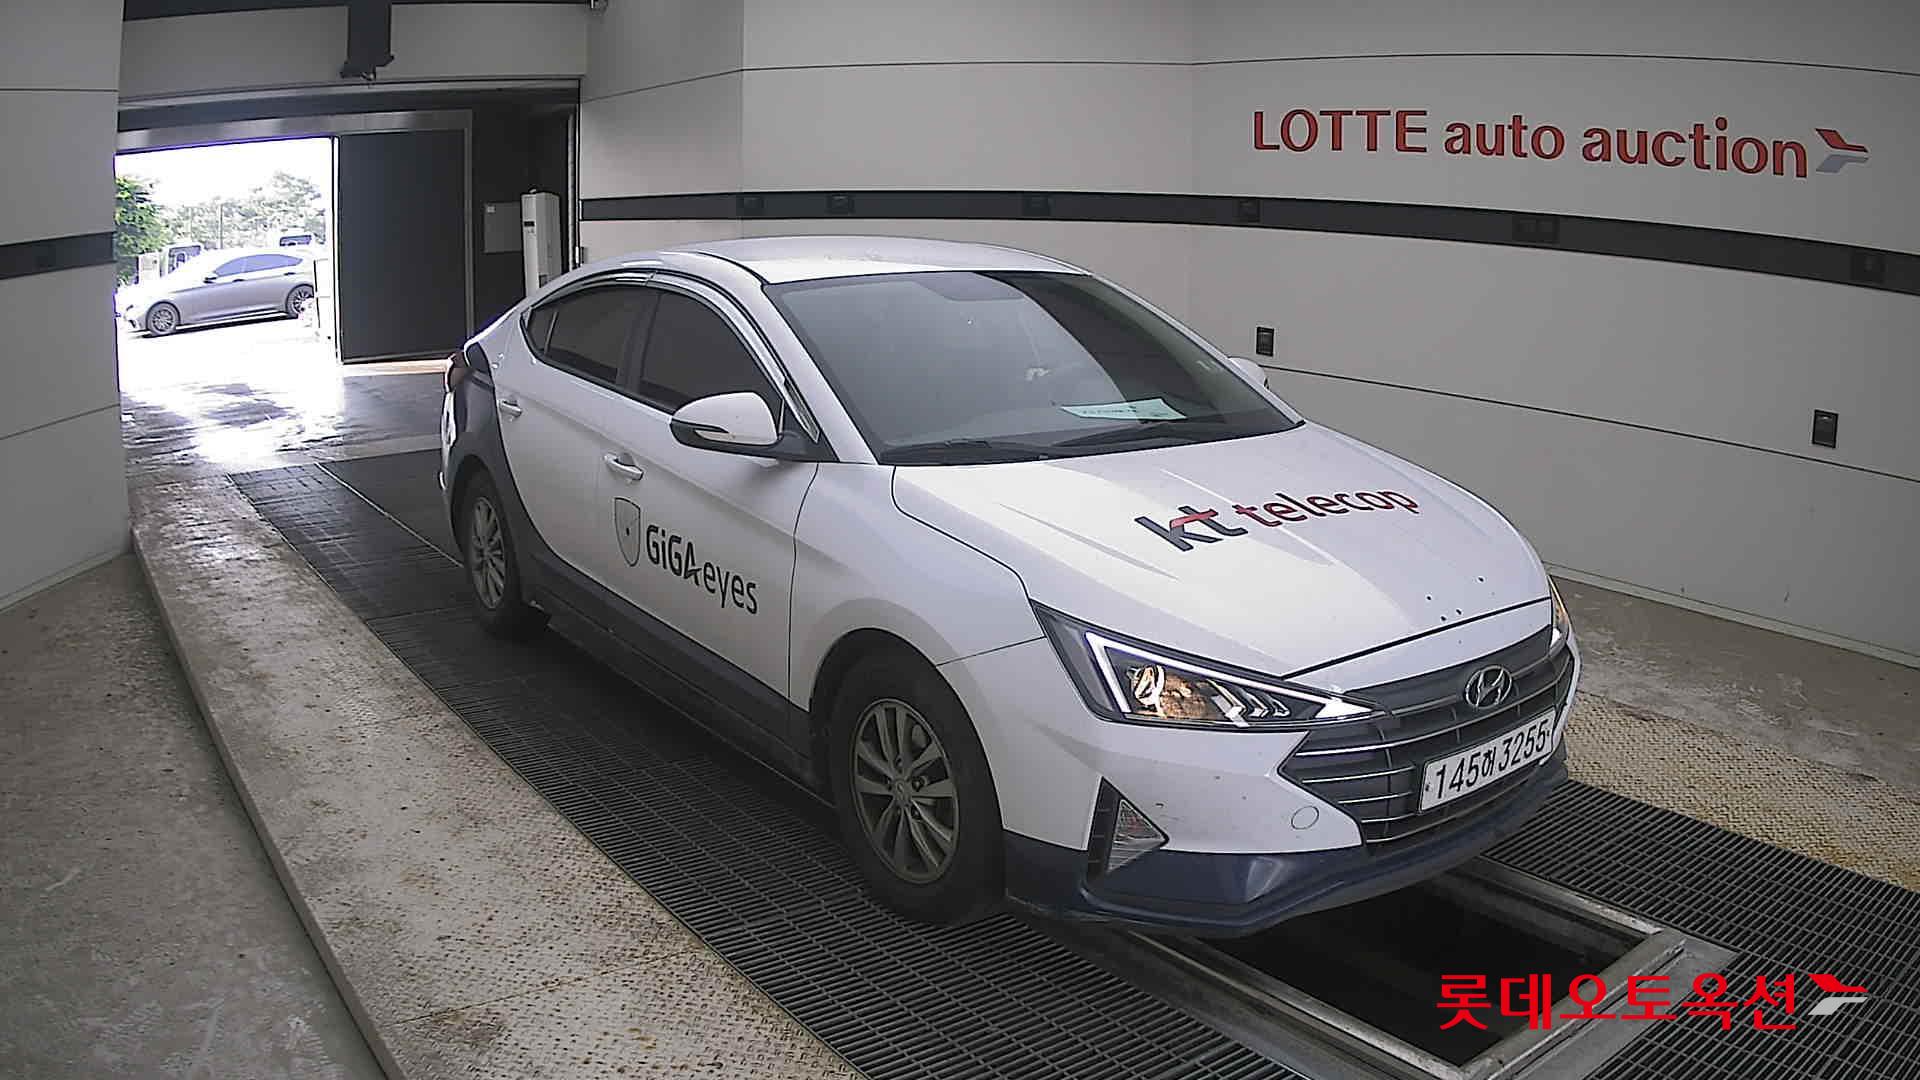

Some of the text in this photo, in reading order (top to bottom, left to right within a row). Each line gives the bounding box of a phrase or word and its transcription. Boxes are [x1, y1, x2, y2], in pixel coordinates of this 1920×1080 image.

[1254, 109, 1808, 178] LOTTE auto auction
[1134, 492, 1420, 552] kt telecop
